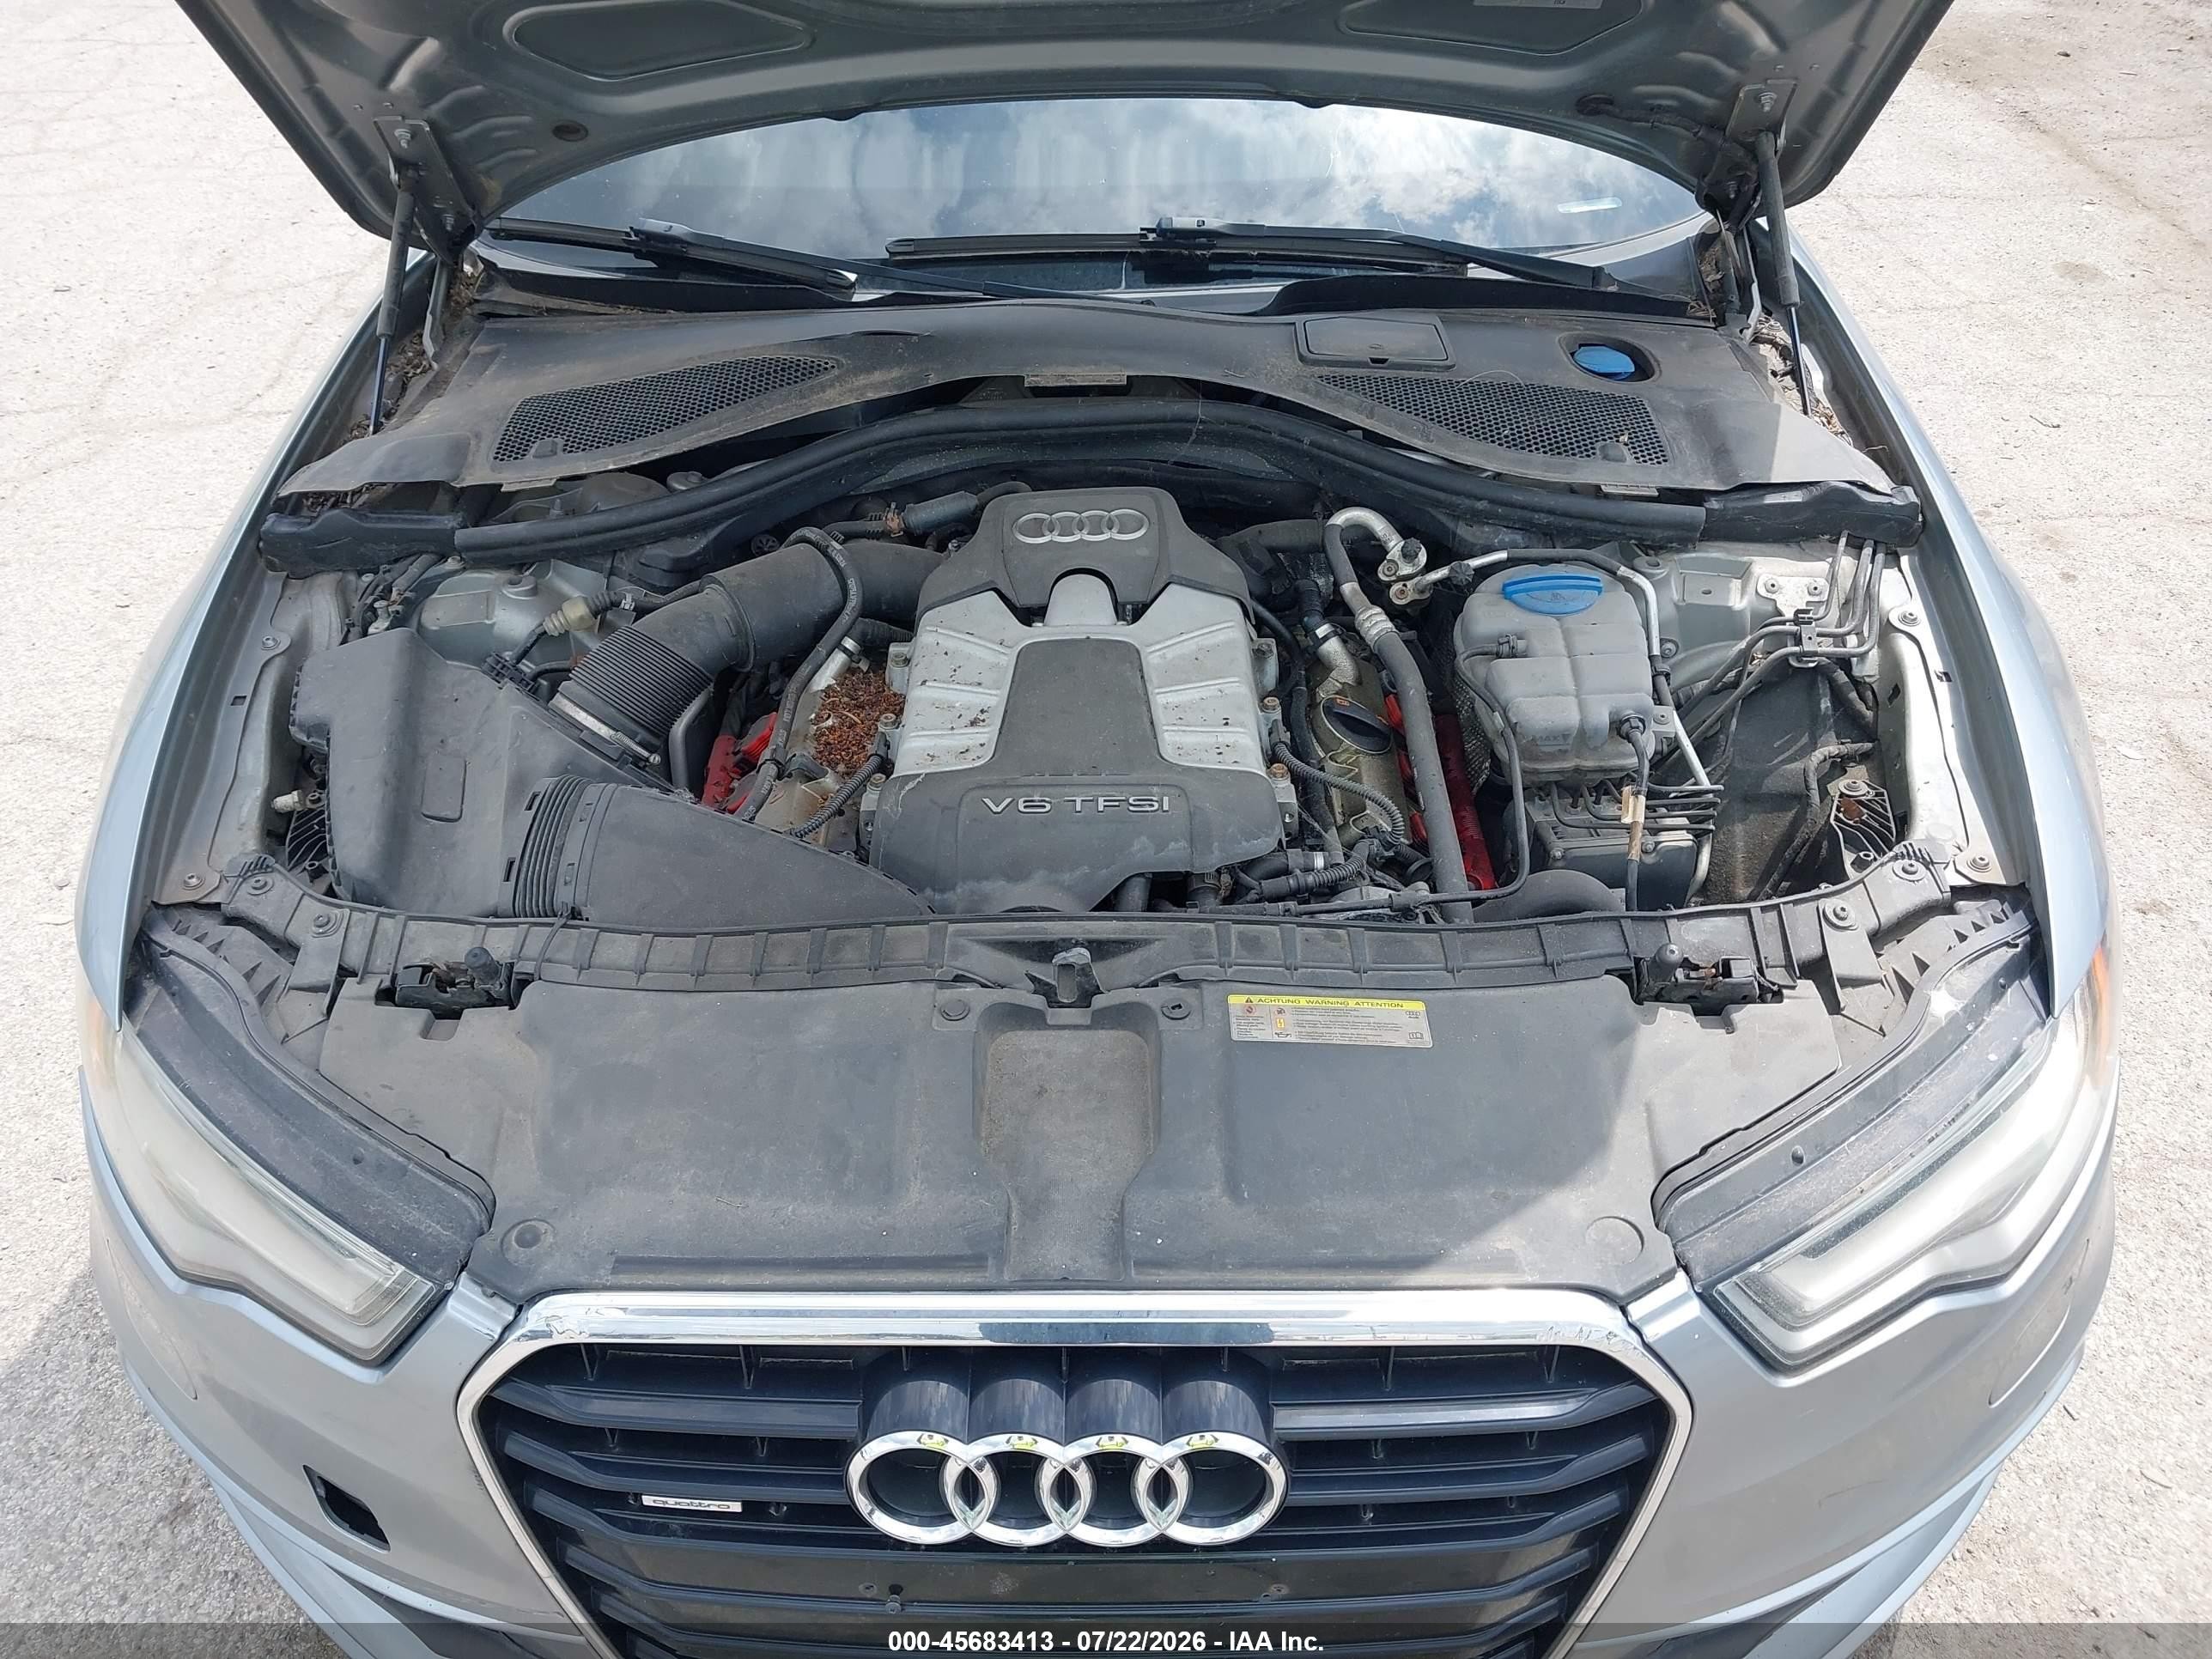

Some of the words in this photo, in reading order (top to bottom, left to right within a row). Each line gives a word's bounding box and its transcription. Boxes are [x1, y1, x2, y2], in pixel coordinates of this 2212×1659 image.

[981, 796, 1053, 814] V6
[1063, 795, 1170, 814] TFSI
[1353, 1000, 1404, 1009] ATTENTION
[653, 1499, 731, 1510] quattro
